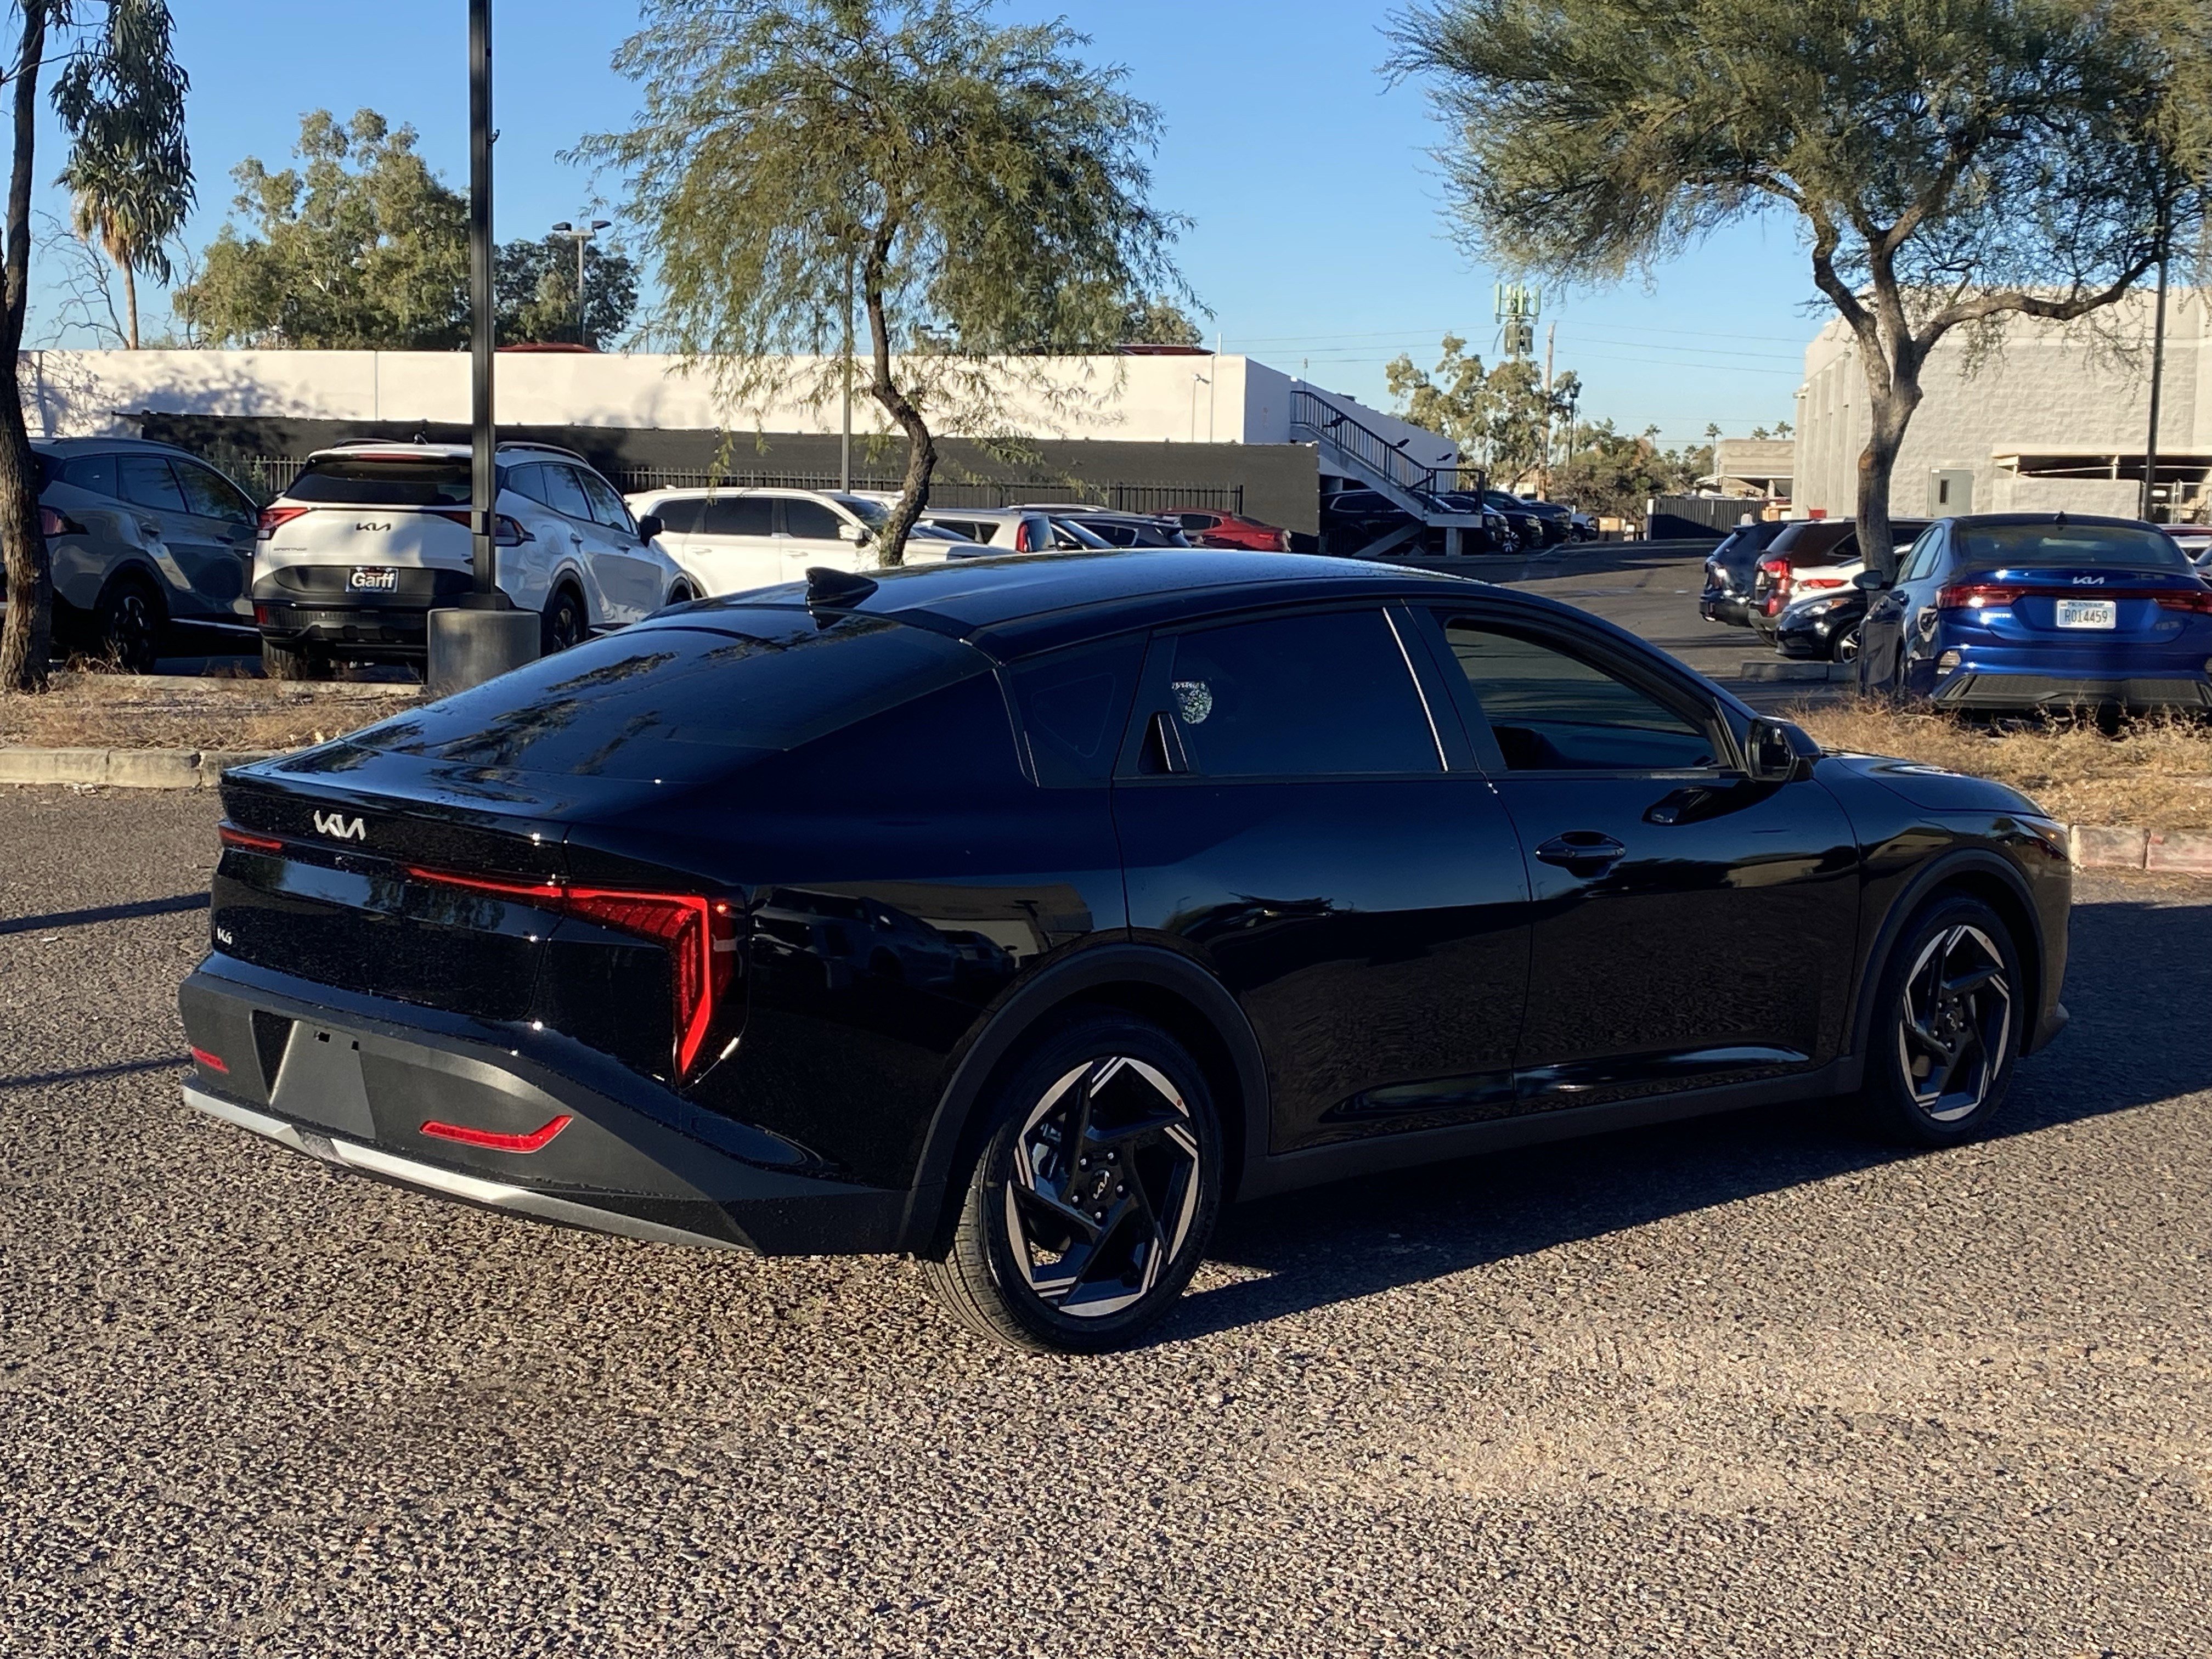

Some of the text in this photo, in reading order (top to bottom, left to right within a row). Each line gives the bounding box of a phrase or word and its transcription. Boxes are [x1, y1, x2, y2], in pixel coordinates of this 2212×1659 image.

[356, 522, 391, 531] KIA
[352, 572, 394, 588] Garff
[2073, 576, 2104, 584] KIA
[313, 810, 366, 840] KIA
[217, 928, 233, 945] K4
